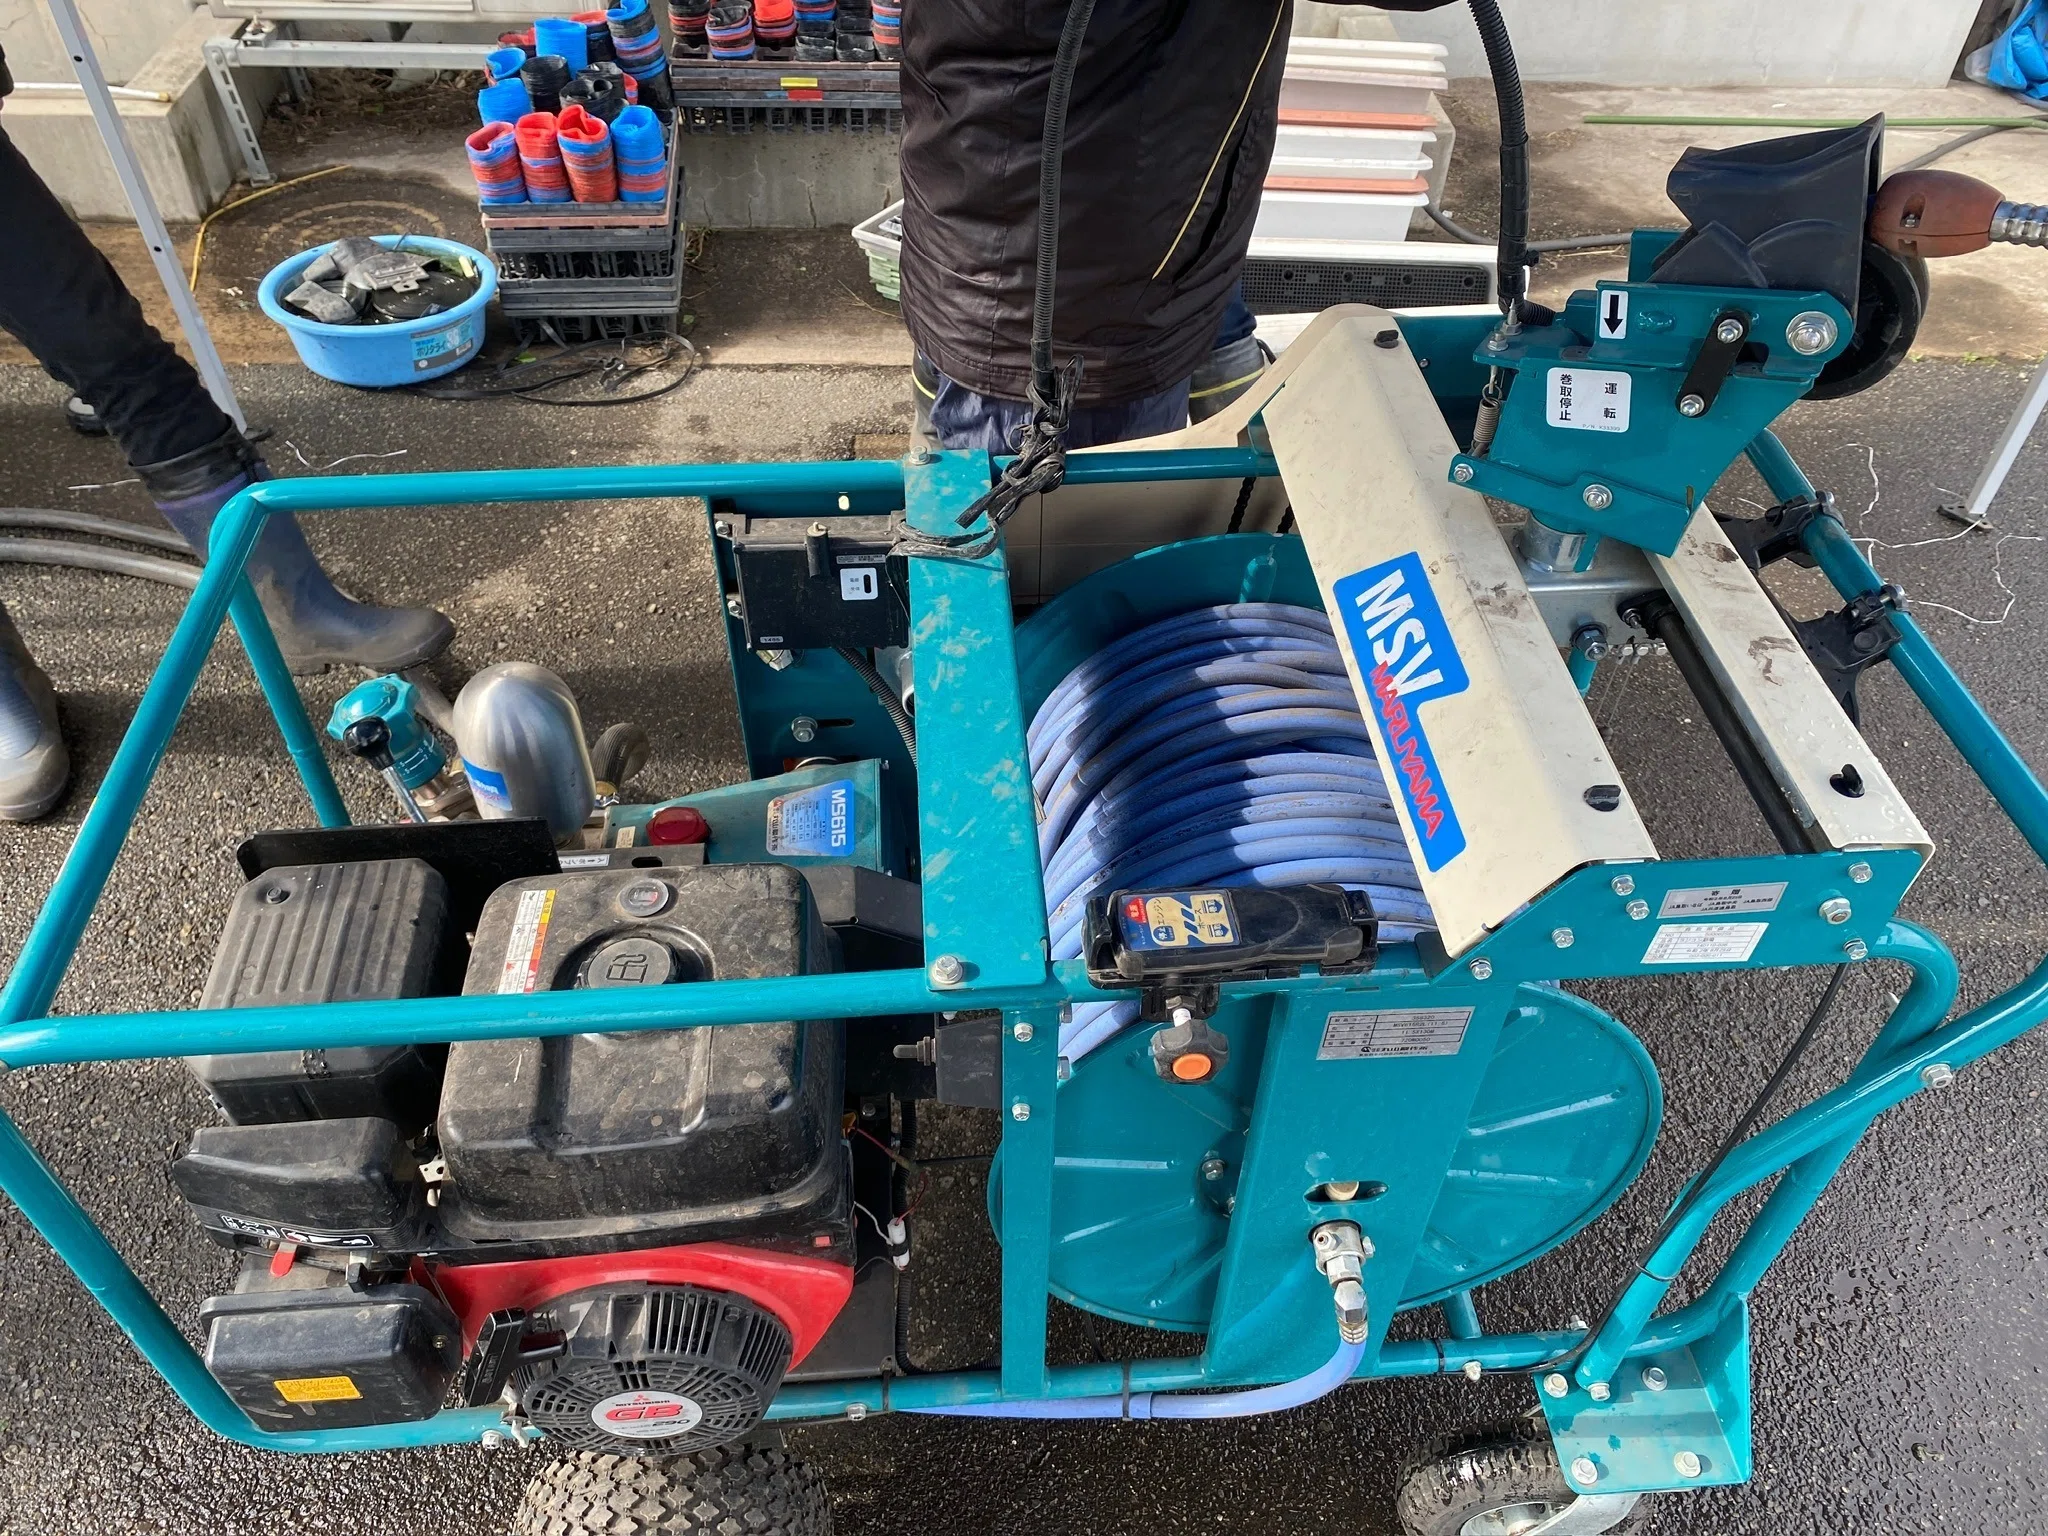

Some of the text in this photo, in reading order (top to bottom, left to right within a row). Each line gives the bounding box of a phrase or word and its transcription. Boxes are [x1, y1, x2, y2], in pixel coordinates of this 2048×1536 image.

[1559, 374, 1572, 421] 巻取停止
[1604, 382, 1618, 419] 運転
[1355, 568, 1444, 699] MSV
[1370, 660, 1444, 840] MARUYAMA
[831, 788, 846, 847] MS615
[1154, 898, 1168, 940] 停止 エンジン
[1195, 908, 1206, 929] ホース
[606, 1404, 683, 1421] GB
